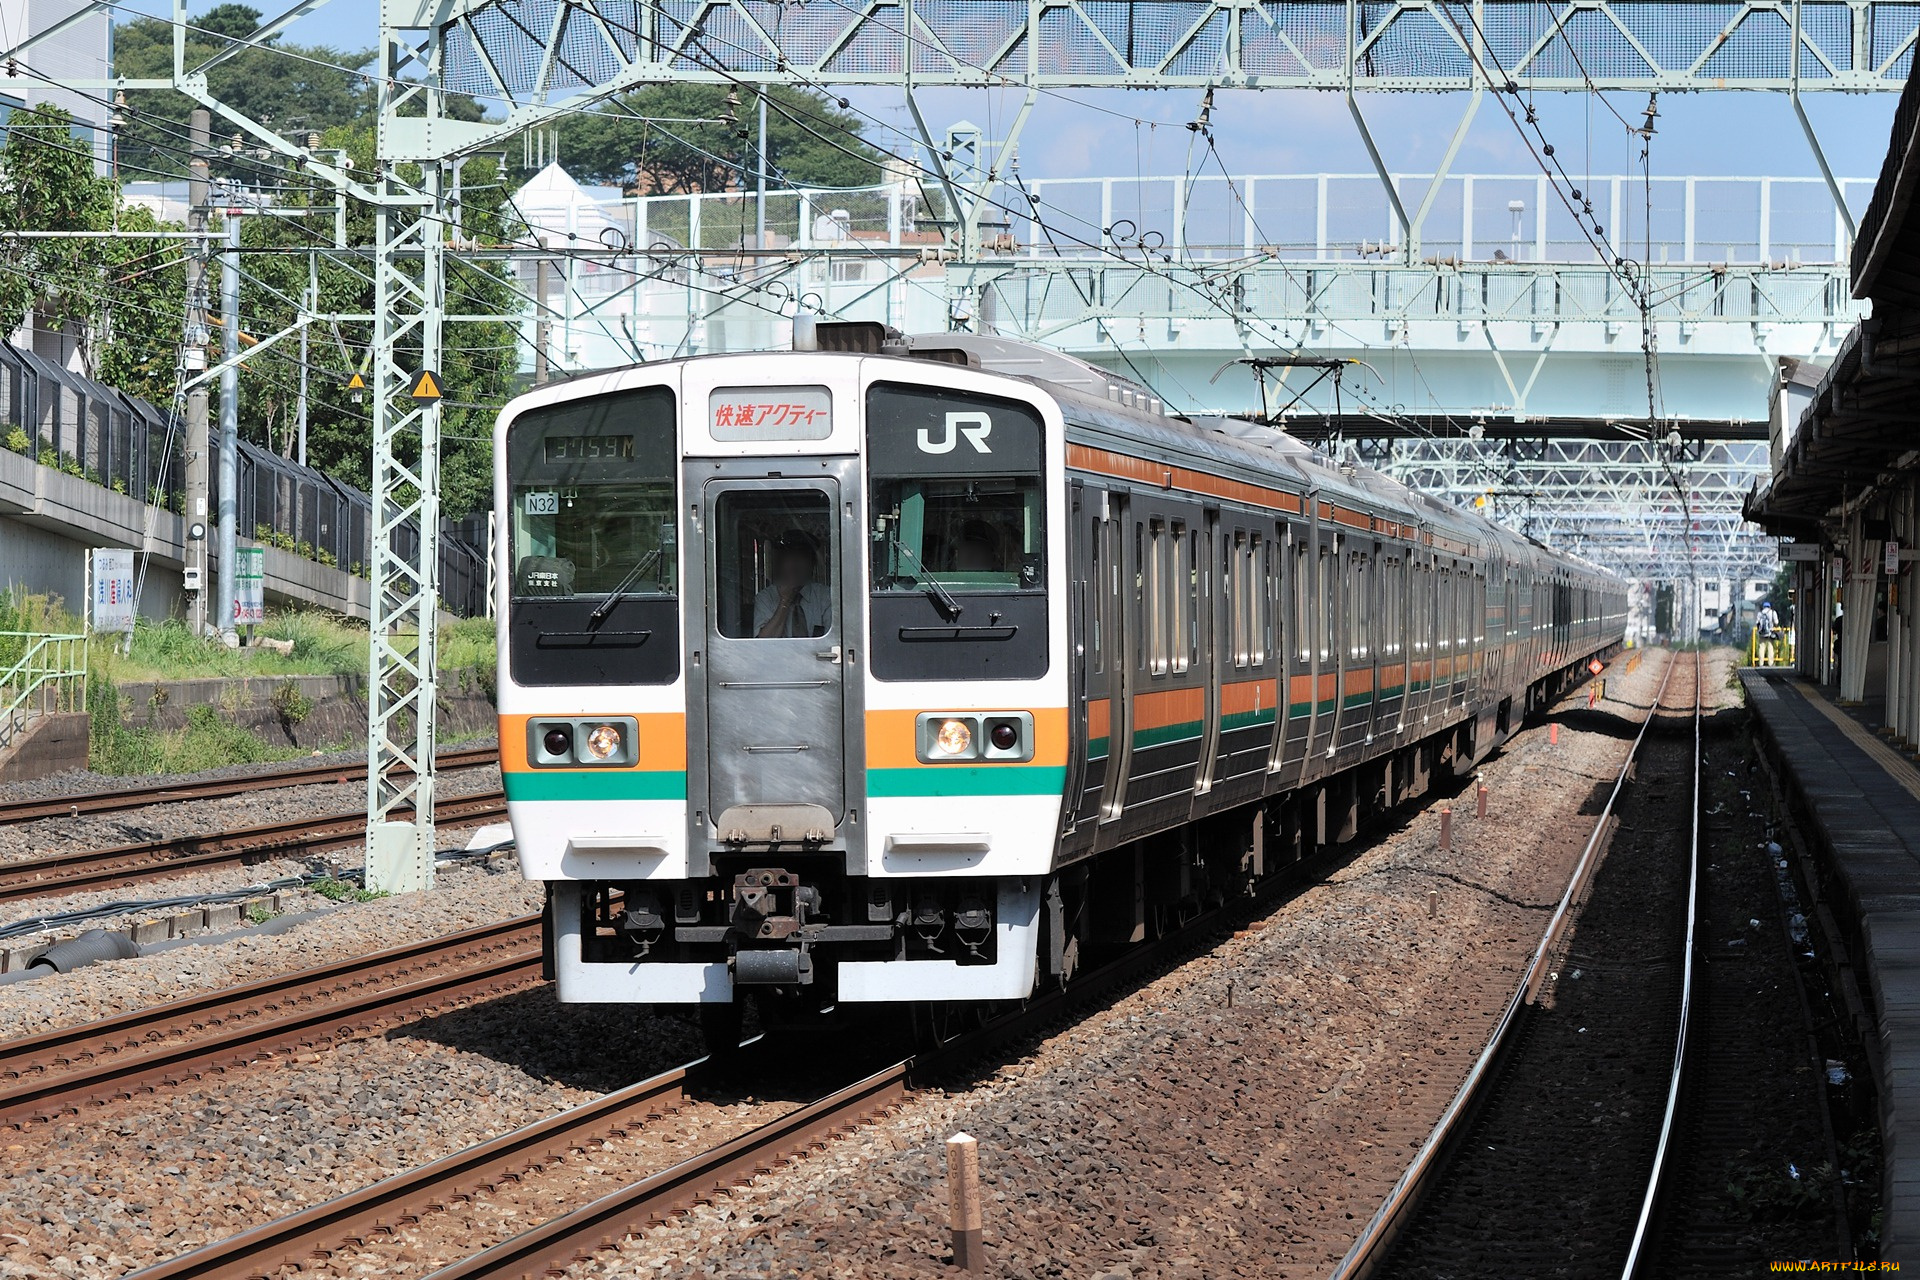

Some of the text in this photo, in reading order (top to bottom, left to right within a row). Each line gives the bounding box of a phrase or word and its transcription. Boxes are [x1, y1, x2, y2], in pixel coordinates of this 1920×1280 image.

[715, 404, 827, 426] 快速アクティー
[917, 411, 992, 454] JR
[529, 498, 555, 512] N32
